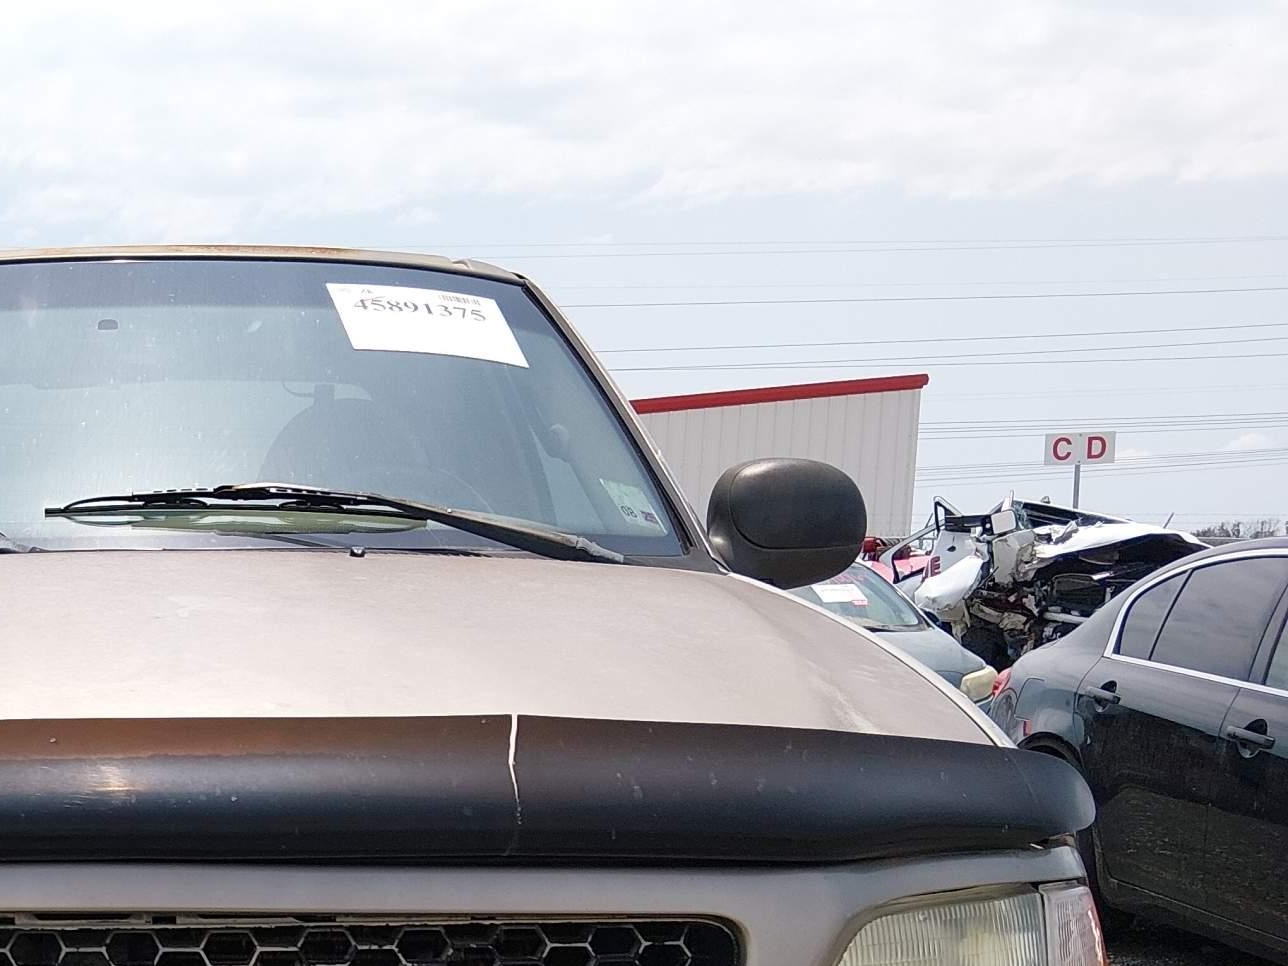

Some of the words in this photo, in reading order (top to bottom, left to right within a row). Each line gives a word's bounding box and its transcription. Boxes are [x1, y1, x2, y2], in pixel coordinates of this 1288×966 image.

[353, 297, 487, 322] 45891375
[1052, 437, 1072, 460] C
[1087, 436, 1106, 459] D
